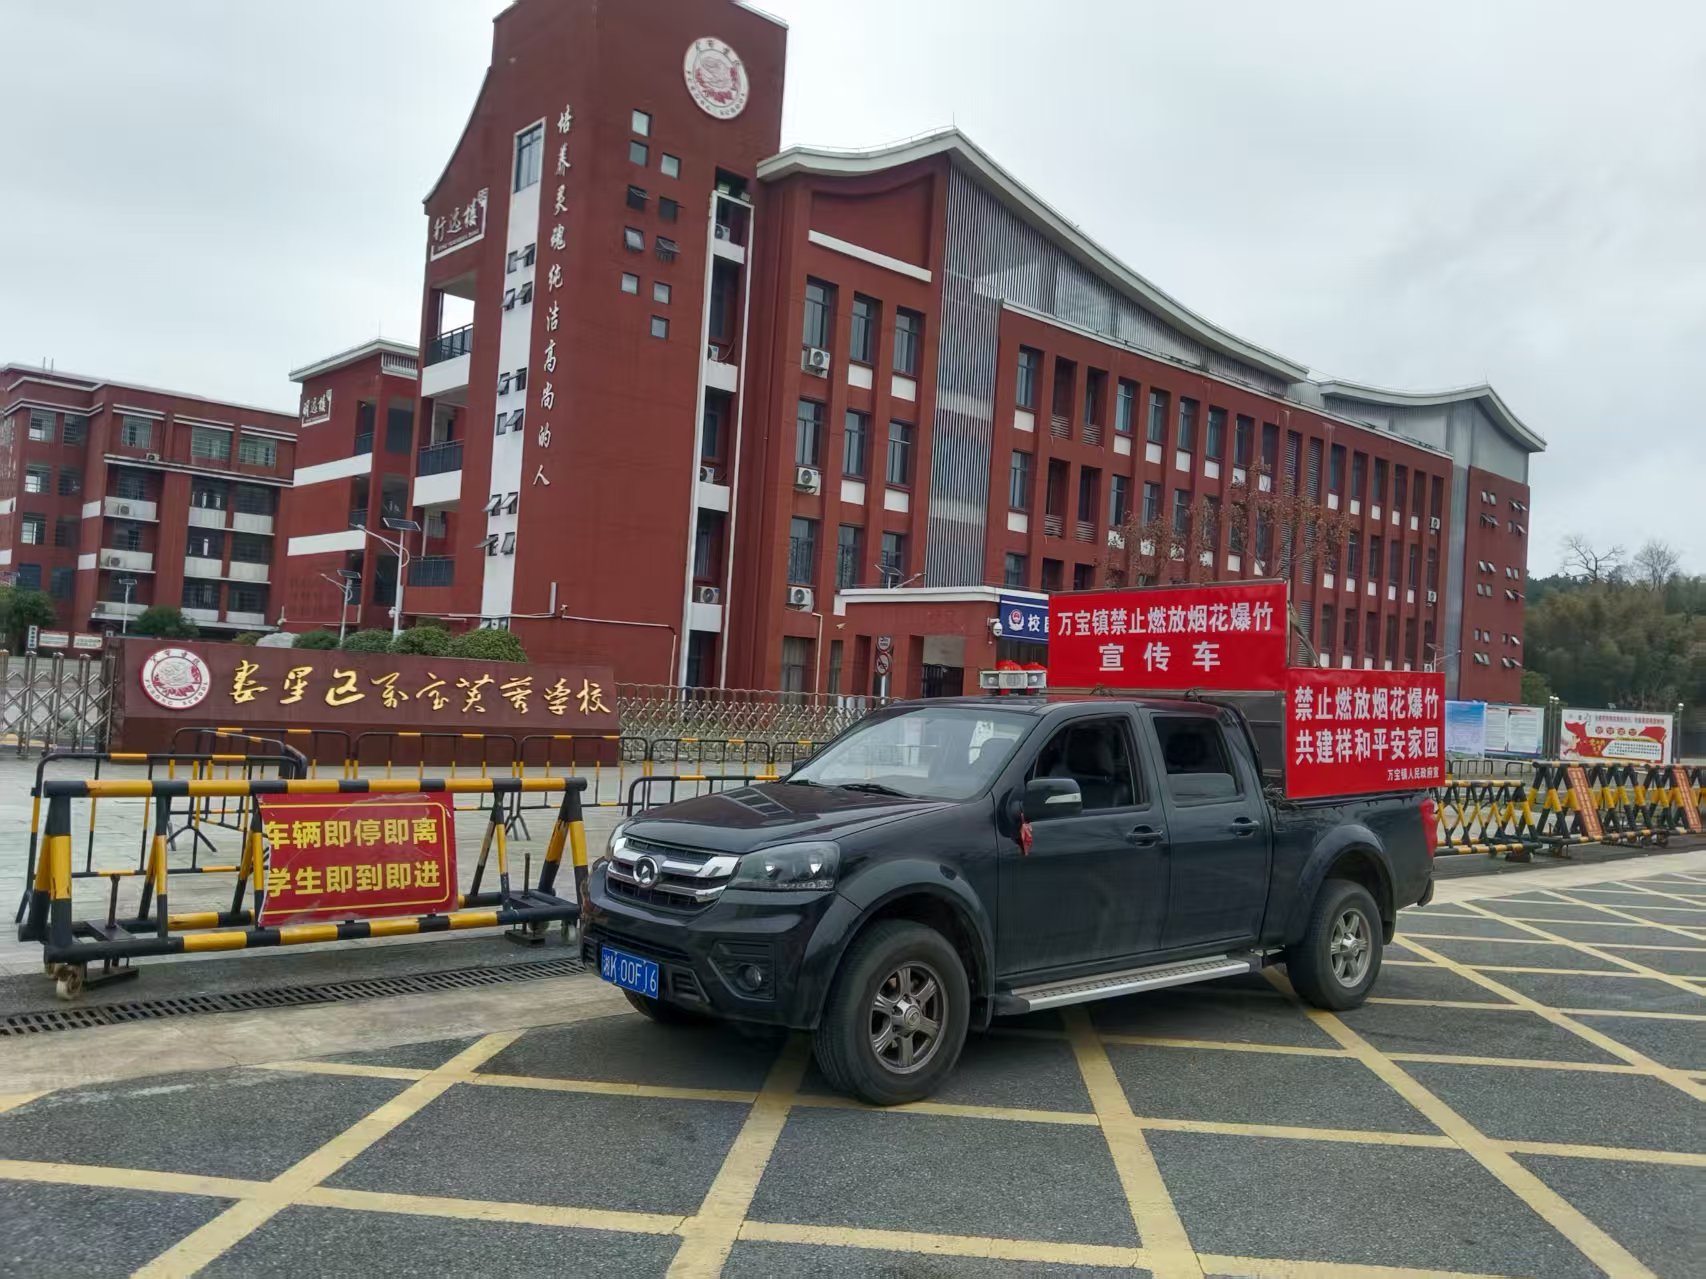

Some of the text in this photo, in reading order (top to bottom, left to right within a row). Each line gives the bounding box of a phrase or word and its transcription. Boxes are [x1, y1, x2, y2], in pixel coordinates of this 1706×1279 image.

[1057, 601, 1274, 636] 万宝镇禁止燃放烟花爆竹
[1098, 640, 1221, 672] 宣传车
[1294, 685, 1440, 722] 禁止燃放烟花爆竹
[1295, 726, 1440, 766] 共建祥和平安家园
[264, 817, 438, 850] 车辆即停即离
[267, 860, 441, 898] 学生即到即进
